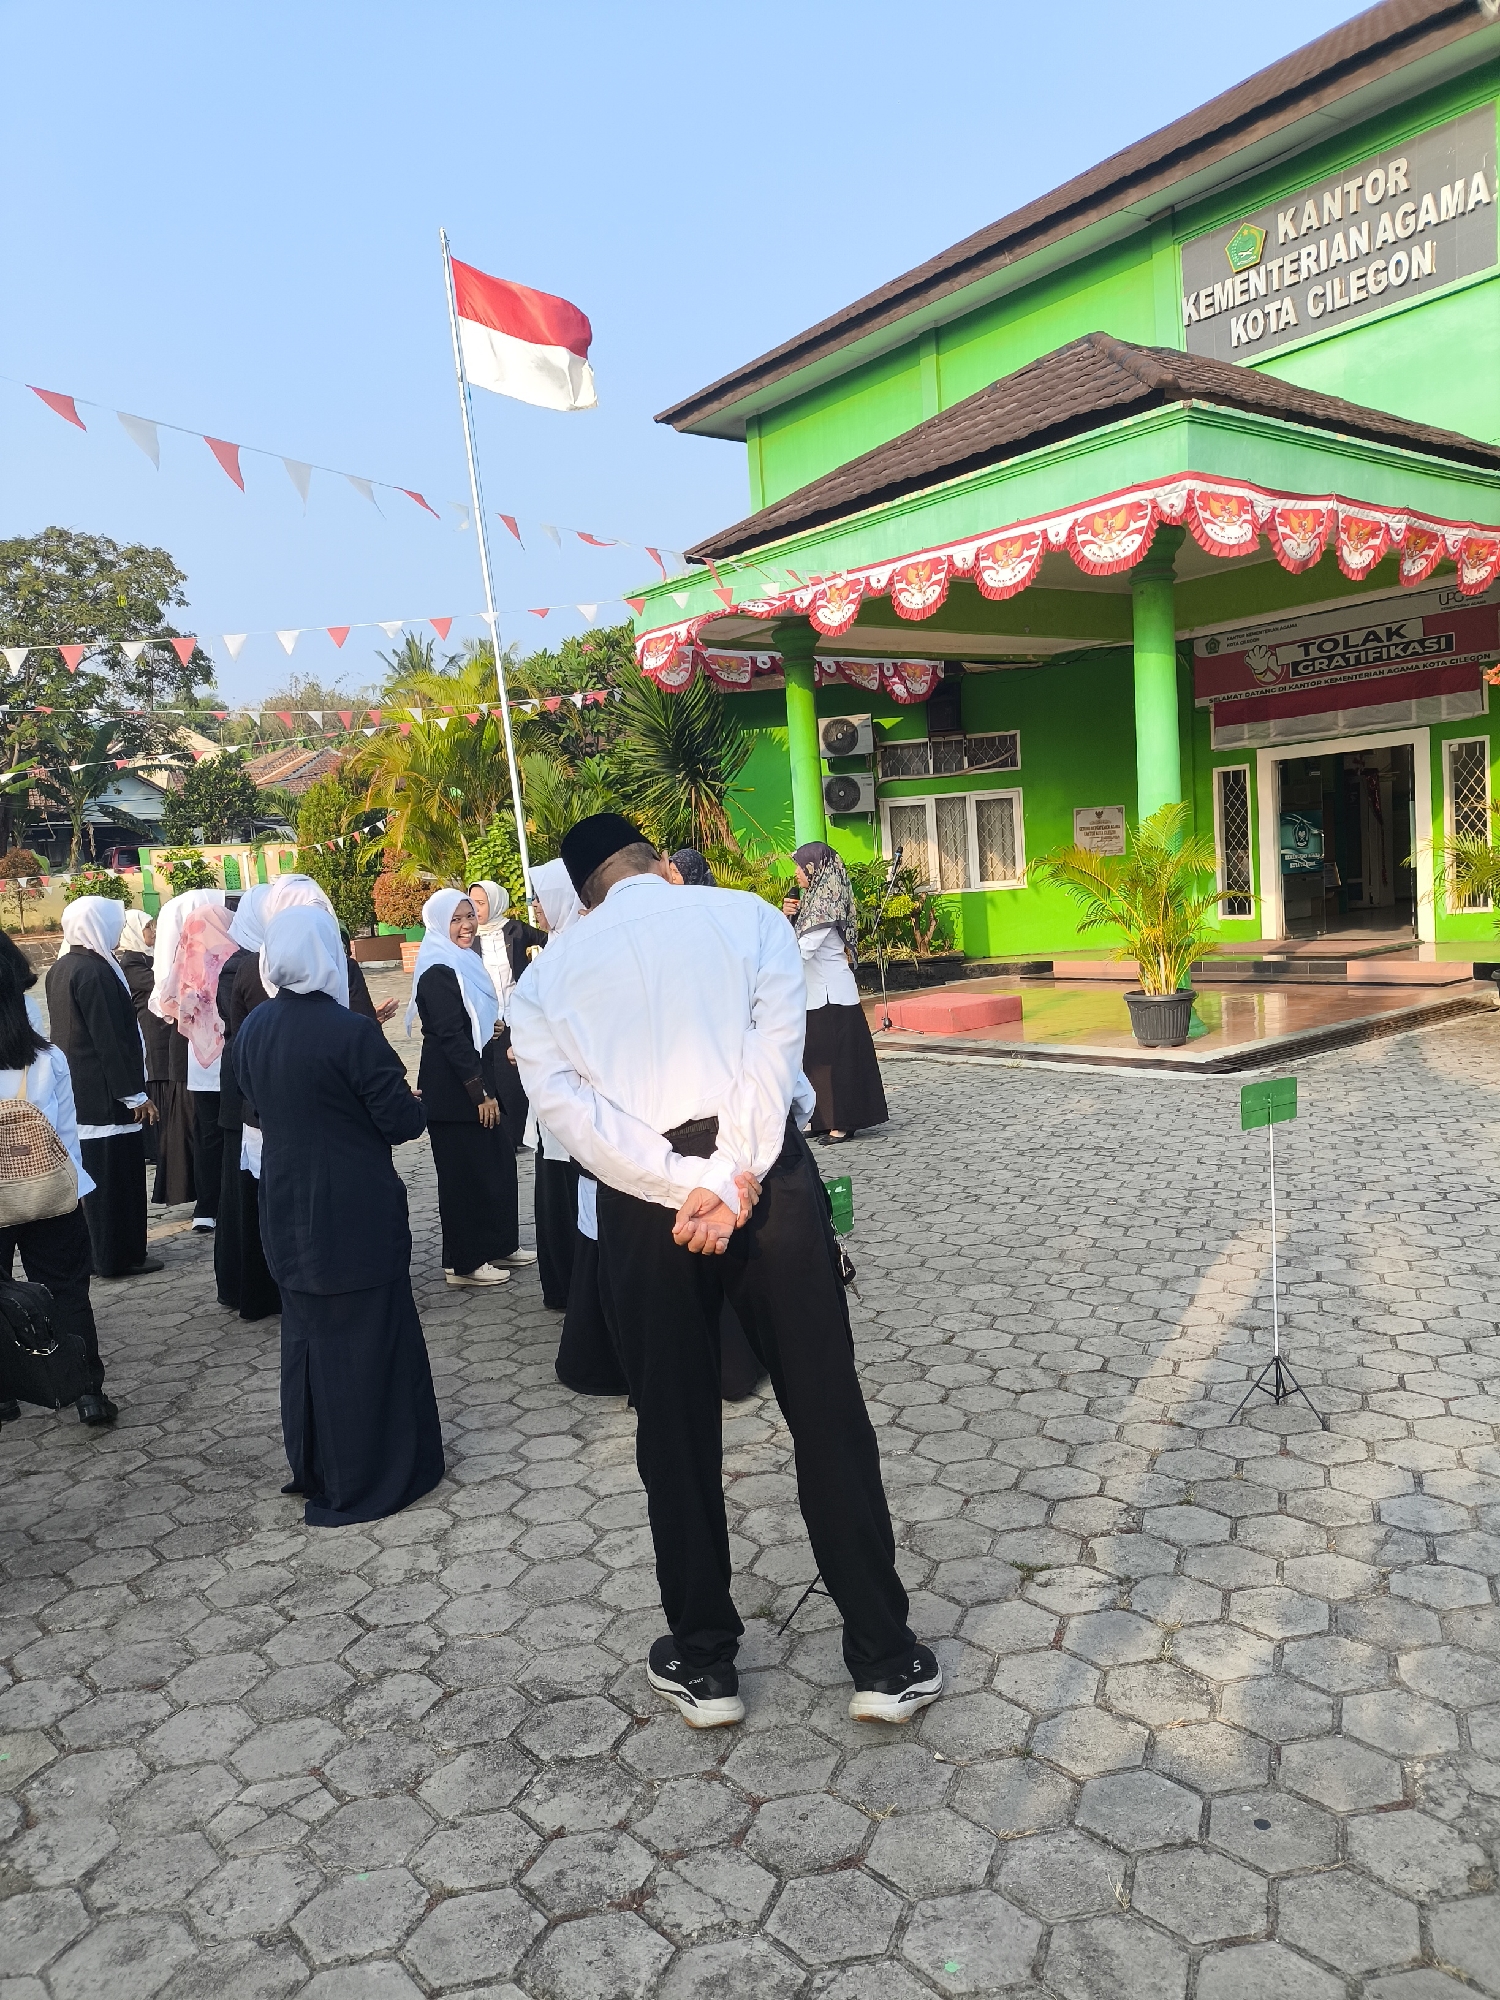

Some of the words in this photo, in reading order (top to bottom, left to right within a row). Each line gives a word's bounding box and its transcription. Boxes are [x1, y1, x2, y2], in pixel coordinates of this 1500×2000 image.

[1277, 157, 1410, 245] KANTOR
[1182, 220, 1370, 326] KEMENTERIAN
[1375, 170, 1493, 250] AGAMA
[1231, 296, 1299, 348] KOTA
[1307, 240, 1437, 318] CILEGON
[1297, 622, 1408, 658] TOLAK
[1297, 635, 1446, 675] GRATIFIKASI
[1208, 693, 1242, 704] SELAMAT
[1245, 687, 1277, 698] DATANG
[1289, 680, 1322, 691] KANTOR
[1323, 669, 1385, 685] KEMENTERIAN
[1386, 664, 1421, 675] AGAMA
[1422, 660, 1448, 670] KOTA
[1450, 653, 1491, 665] CILEGON
